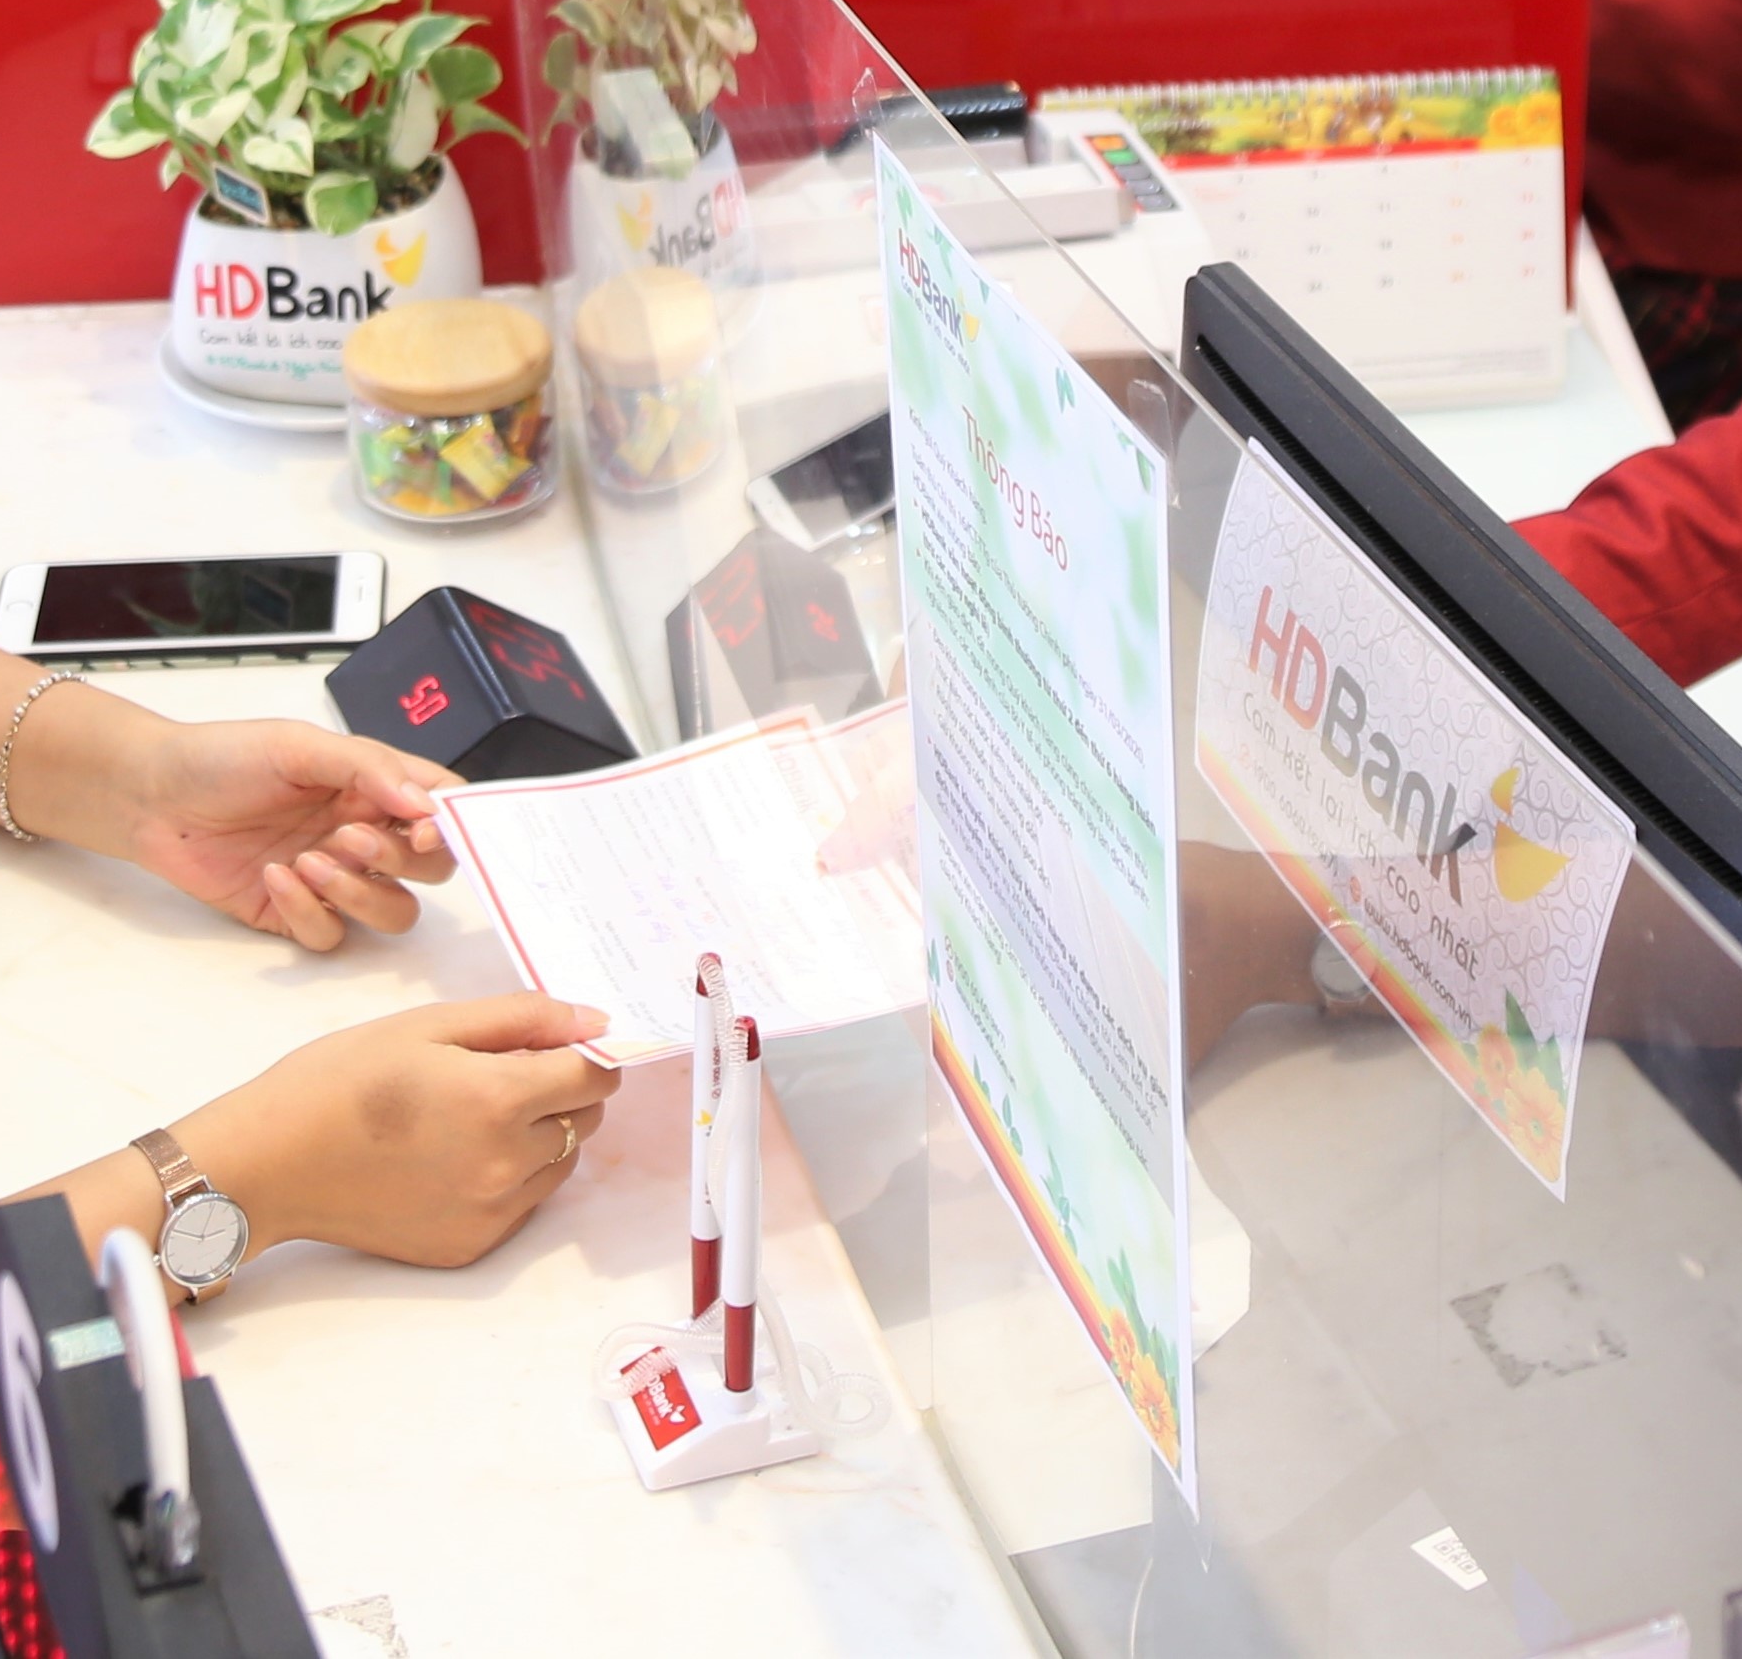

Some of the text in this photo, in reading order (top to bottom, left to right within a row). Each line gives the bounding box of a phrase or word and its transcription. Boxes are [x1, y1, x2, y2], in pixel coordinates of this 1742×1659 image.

[195, 264, 394, 322] HDBank
[898, 229, 963, 345] HDBank
[962, 405, 1067, 576] Thông Báo
[1067, 706, 1073, 726] 2
[1105, 758, 1112, 779] 6
[1249, 585, 1477, 908] HDBank
[1244, 692, 1276, 747] Cam
[1283, 736, 1313, 791] kết
[1352, 816, 1377, 867] ích
[1386, 866, 1421, 914] cao
[1430, 915, 1479, 981] nhất
[1364, 897, 1473, 1031] www.hdbank.com.vn
